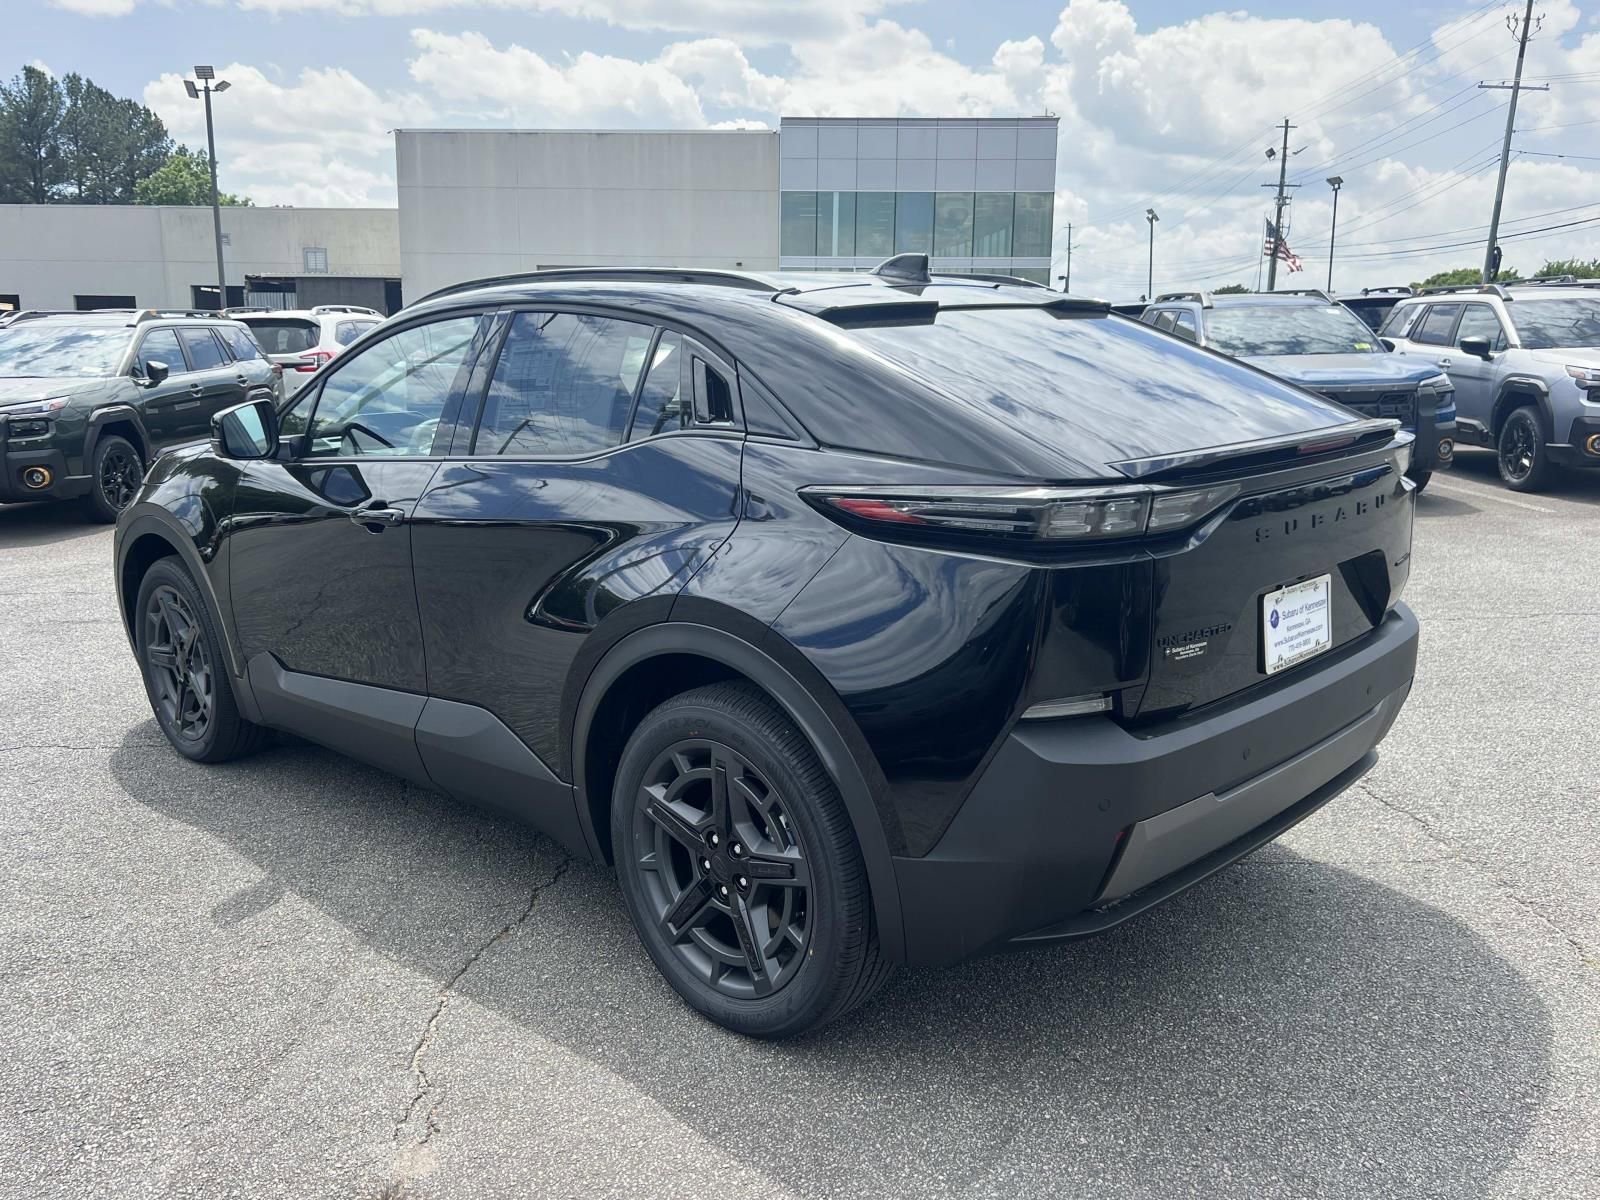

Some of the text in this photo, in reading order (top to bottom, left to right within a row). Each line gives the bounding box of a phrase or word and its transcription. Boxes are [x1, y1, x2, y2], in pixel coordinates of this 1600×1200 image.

[1255, 494, 1385, 542] SUBARU
[1282, 599, 1327, 620] Subaru of Kennesaw
[1304, 618, 1312, 626] GA
[1156, 623, 1232, 647] UNCHARTED
